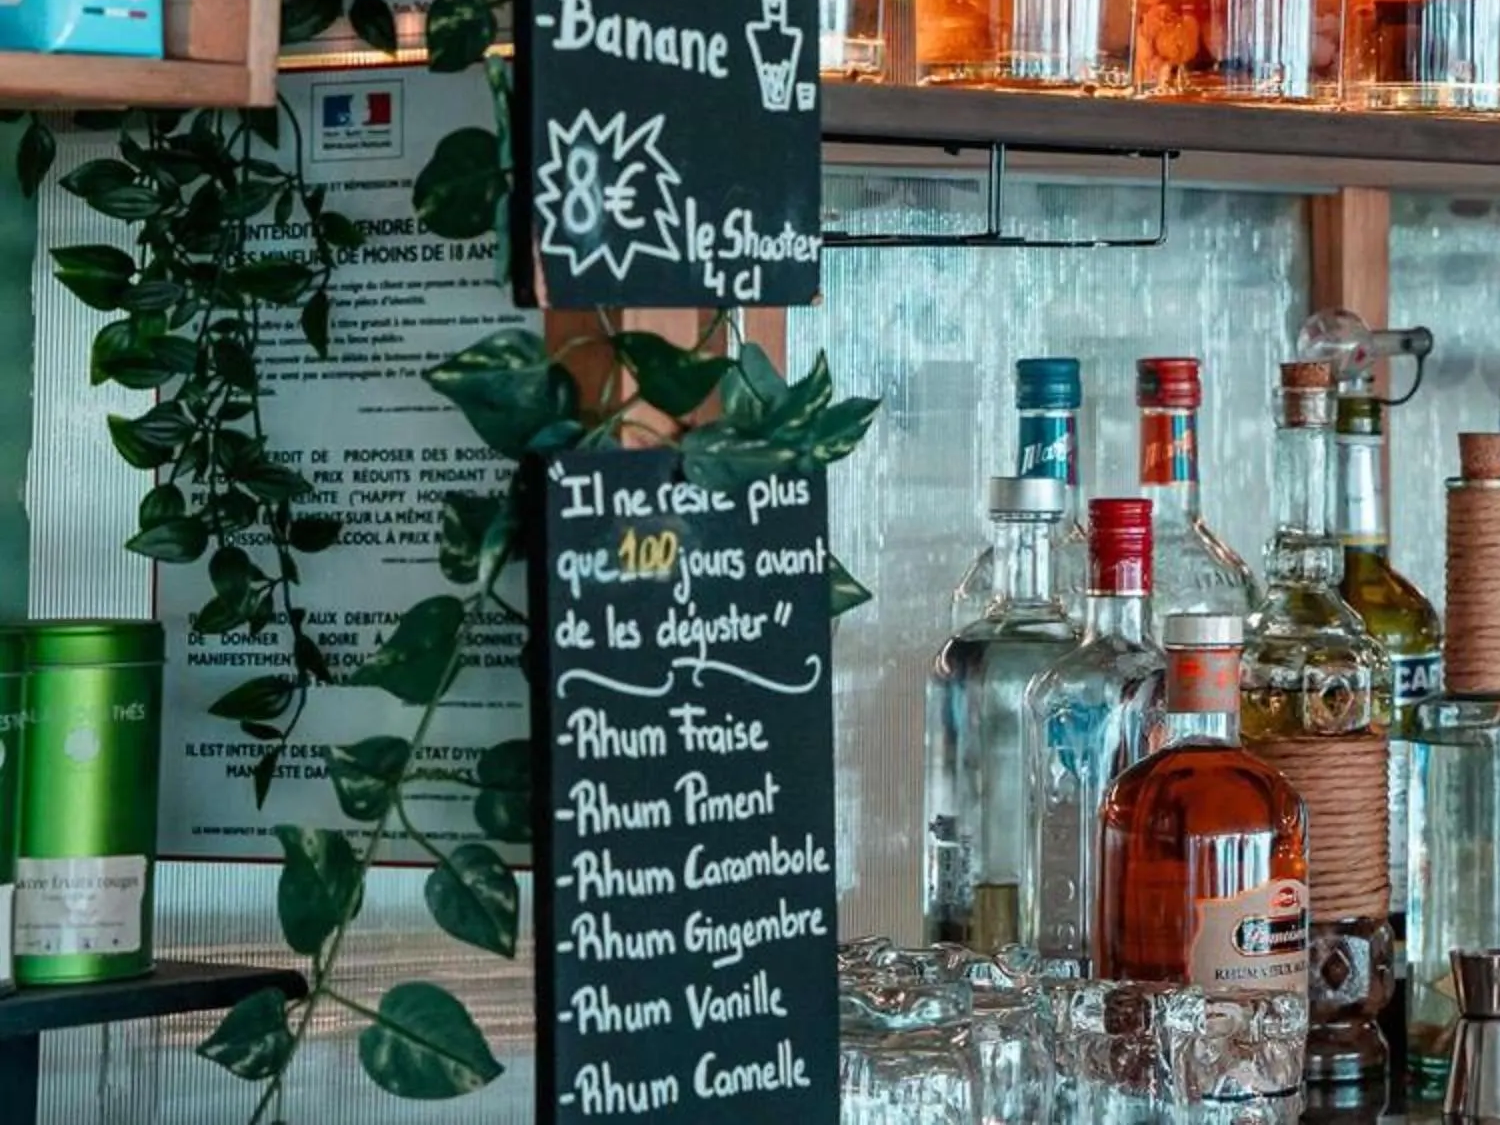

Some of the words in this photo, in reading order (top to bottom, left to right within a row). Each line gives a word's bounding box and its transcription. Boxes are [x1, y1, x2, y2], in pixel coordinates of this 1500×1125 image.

[562, 145, 646, 234] 8€
[339, 246, 359, 265] DE
[362, 244, 418, 264] MOINS
[421, 242, 444, 262] DE
[449, 241, 462, 260] 18
[686, 196, 714, 265] le
[719, 208, 825, 264] Shooter
[311, 449, 329, 463] DE
[344, 448, 414, 463] PROPOSER
[422, 448, 448, 462] DES
[314, 470, 343, 484] PRIX
[420, 469, 485, 482] PENDANT
[376, 511, 392, 524] LA
[614, 480, 652, 517] ne
[748, 474, 811, 525] plus
[400, 531, 430, 545] PRIX
[557, 544, 609, 600] que
[617, 529, 678, 574] 100
[675, 545, 746, 604] jours
[756, 538, 827, 577] avant
[318, 632, 358, 645] BOIRE
[557, 606, 596, 651] de
[607, 604, 642, 651] les
[187, 652, 293, 666] MANIFESTEMEN
[670, 702, 769, 754] Fraise
[675, 771, 781, 827] Piment
[684, 833, 831, 891] Carambole
[684, 900, 828, 970] Gingembre
[686, 970, 788, 1032] Vanille
[694, 1039, 811, 1100] Cannelle
